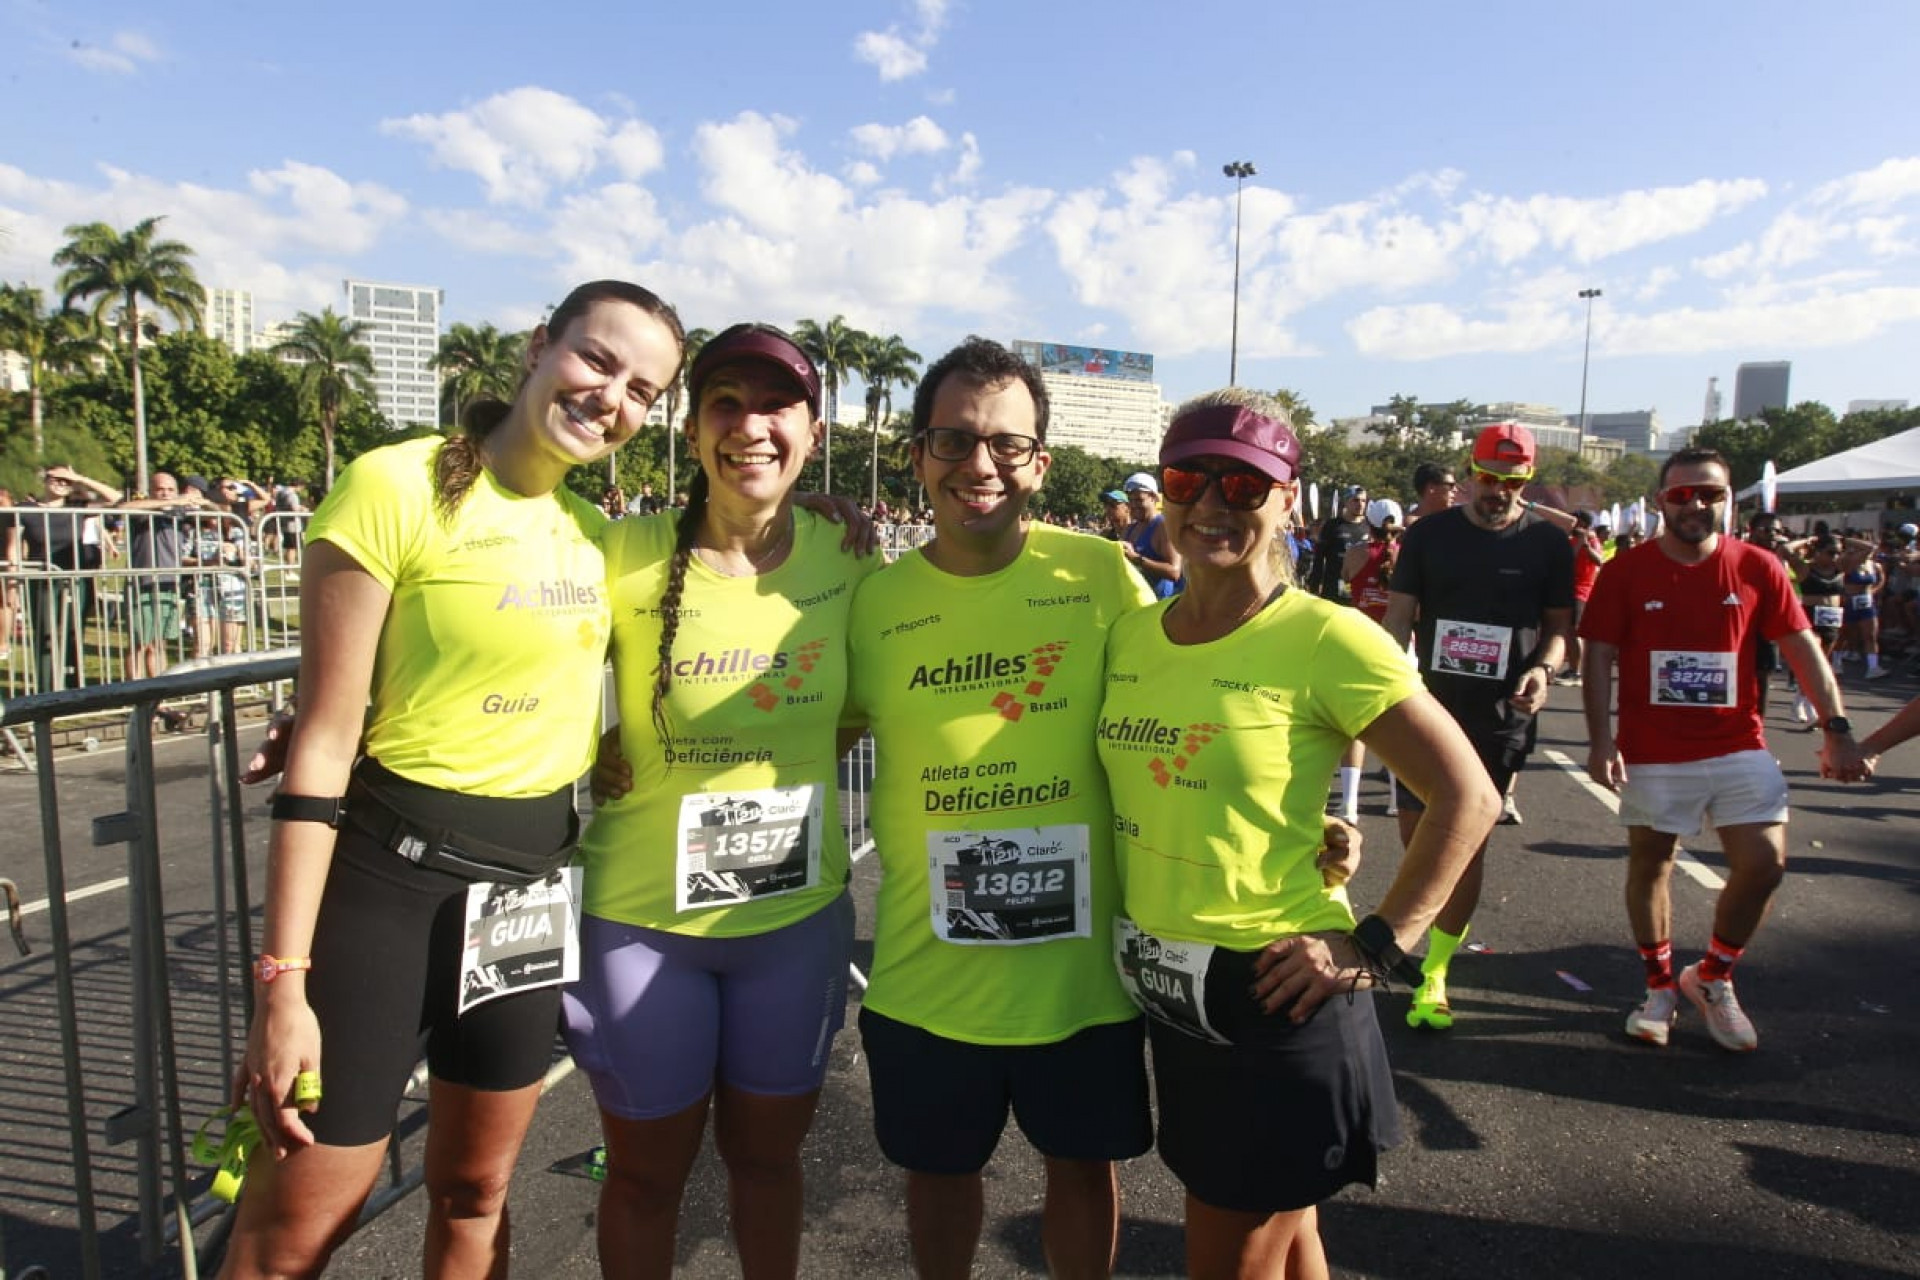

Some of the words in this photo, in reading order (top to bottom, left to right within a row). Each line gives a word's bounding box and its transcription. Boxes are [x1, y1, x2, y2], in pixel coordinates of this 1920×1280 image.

[496, 578, 598, 611] Achilles
[1026, 594, 1090, 607] Track&Field
[908, 652, 1027, 690] Achilles
[934, 676, 1027, 695] INTERNATIONAL
[482, 692, 539, 714] Guia
[787, 692, 823, 705] Brazil
[1030, 698, 1068, 713] Brazil
[702, 735, 734, 745] com
[1098, 717, 1181, 745] Achilles
[665, 747, 773, 764] Deficiência
[1109, 742, 1176, 755] INTERNATIONAL
[921, 765, 970, 782] Atleta
[976, 760, 1017, 777] com
[925, 776, 1070, 811] Deficiência
[1174, 776, 1207, 790] Brazil
[713, 826, 802, 856] 13572
[973, 869, 1065, 895] 13612
[490, 912, 553, 947] GUIA
[1141, 967, 1187, 1003] GUIA
